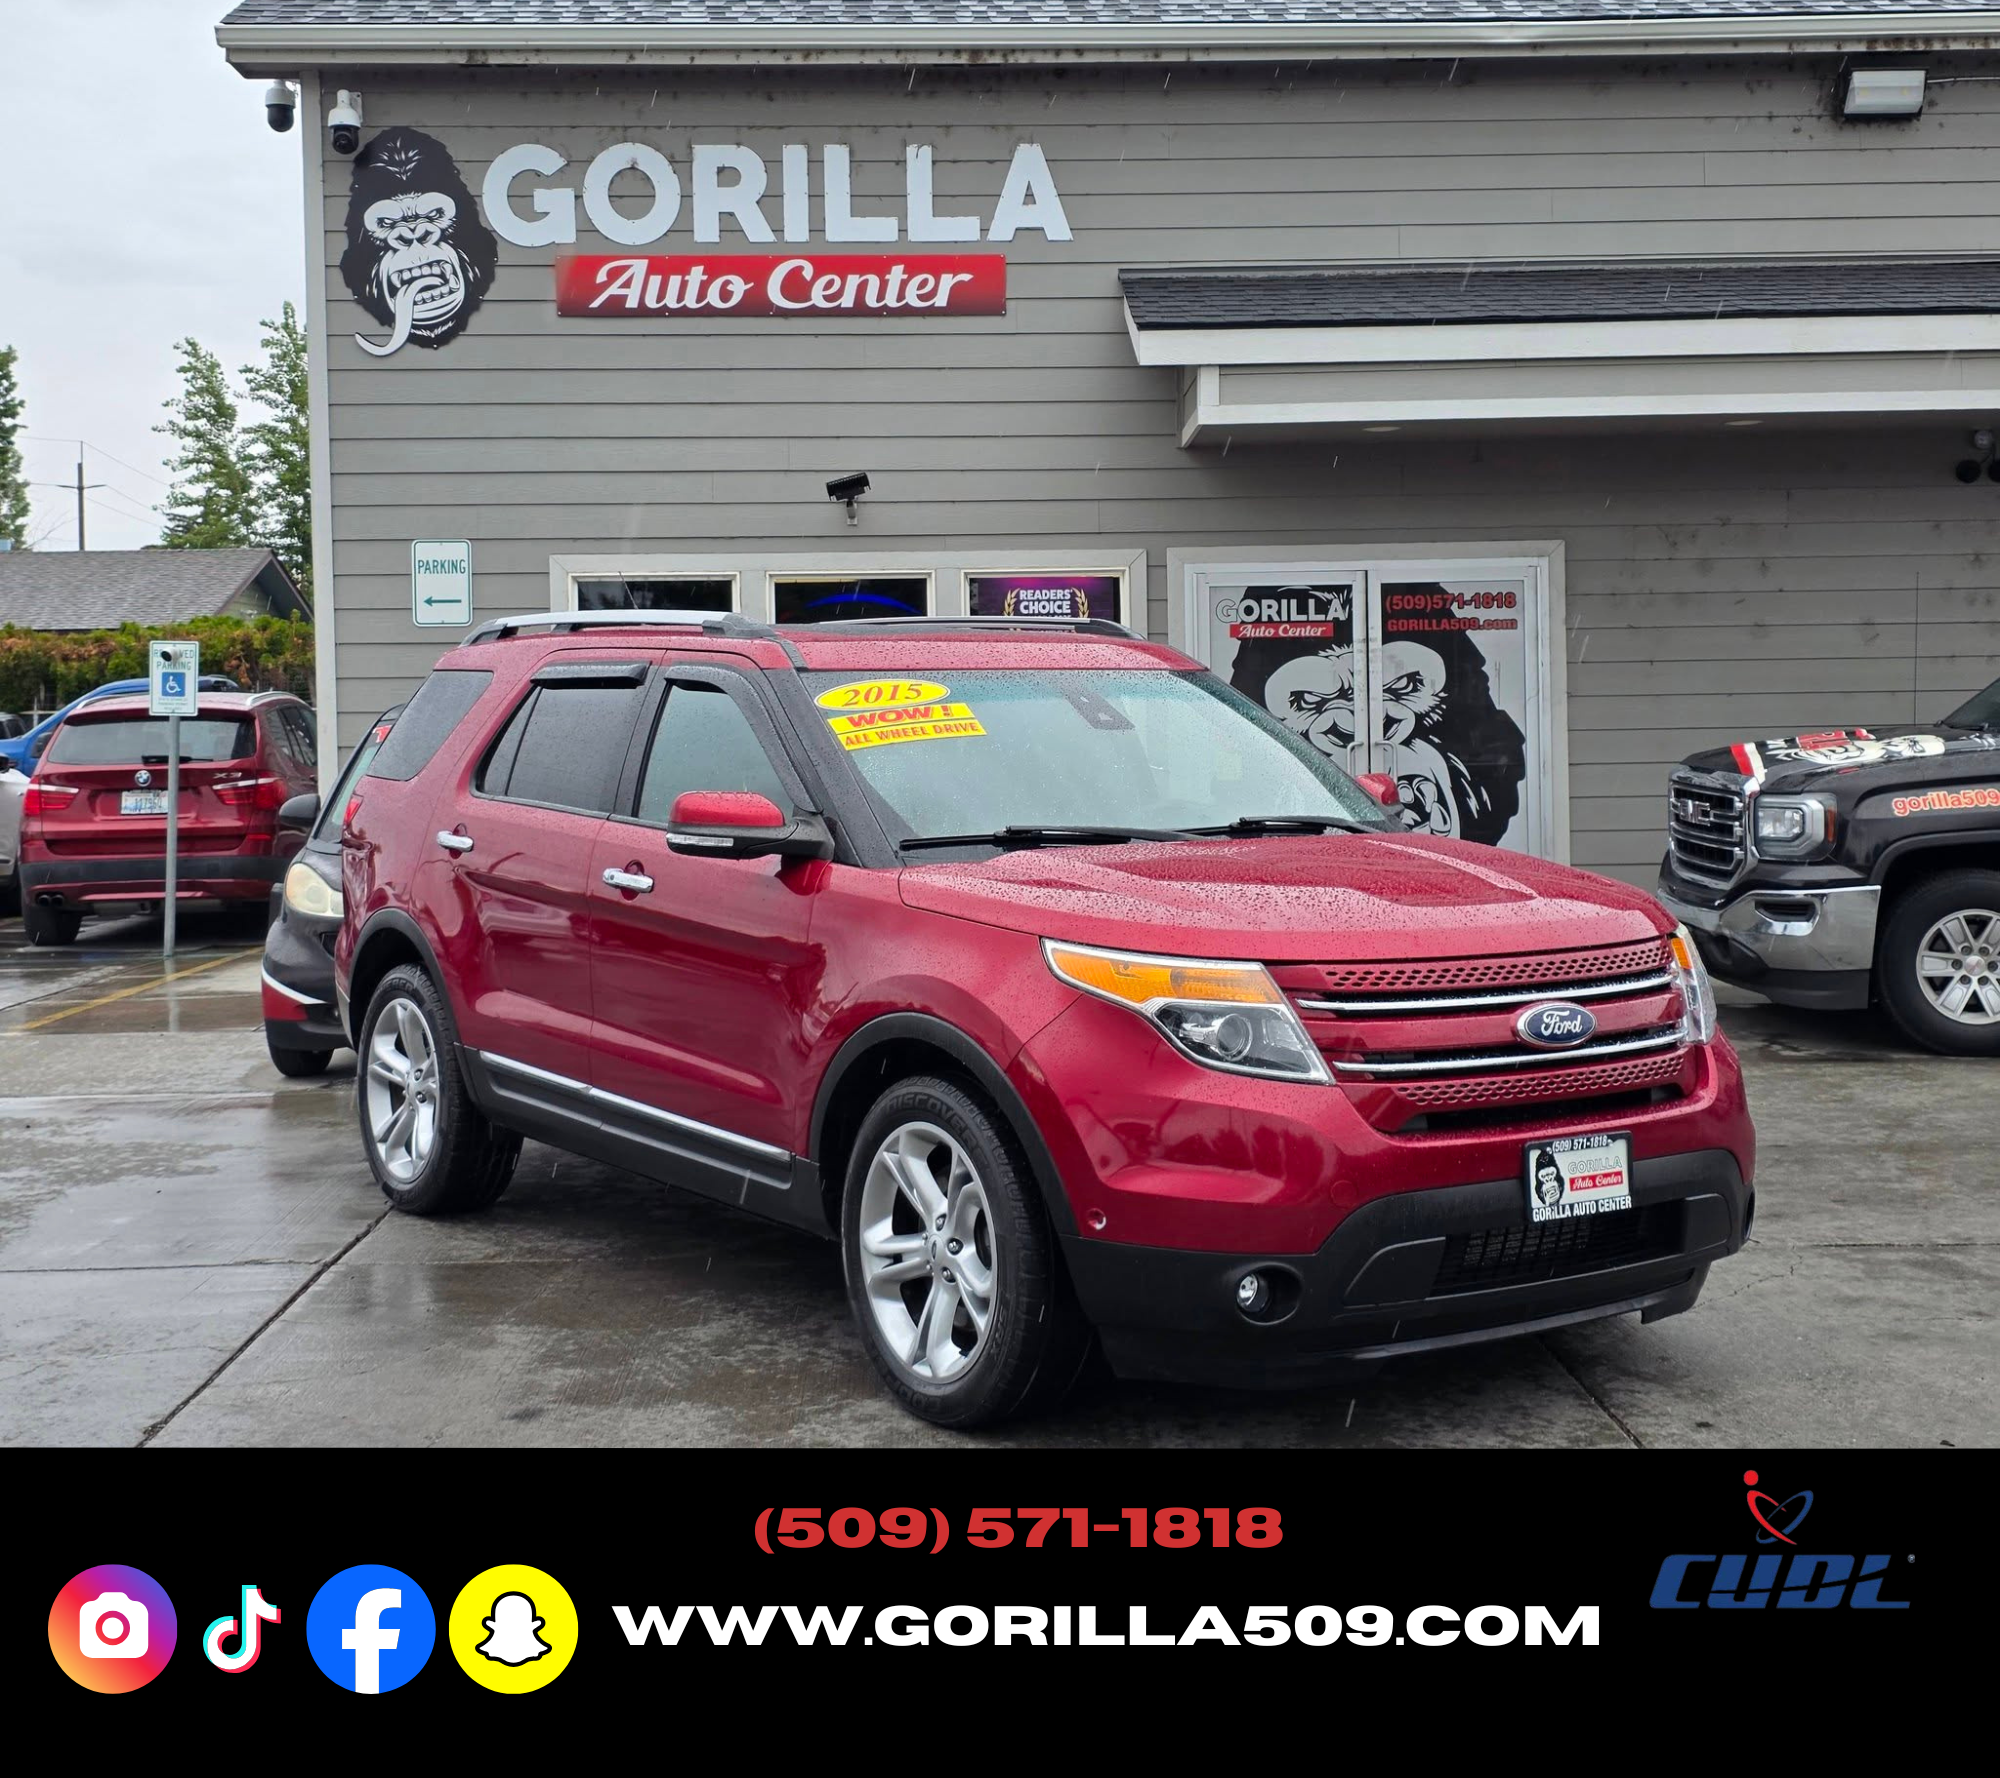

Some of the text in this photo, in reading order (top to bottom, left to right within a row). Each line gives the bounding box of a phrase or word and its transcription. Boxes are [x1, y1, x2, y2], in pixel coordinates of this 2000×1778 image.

[482, 142, 1075, 247] GORILLA
[590, 259, 974, 310] Auto Center
[417, 560, 467, 575] PARKING
[1020, 589, 1073, 600] READERS'
[1386, 592, 1516, 613] (509)571-1818
[1019, 600, 1072, 614] CHOICE
[1216, 598, 1346, 623] GORILLA
[1239, 624, 1326, 638] Auto Center
[1388, 617, 1518, 632] GORILLA509.com
[153, 648, 195, 659] REVED
[157, 660, 192, 671] PARKING
[842, 684, 922, 707] 2015
[847, 706, 934, 728] WOW
[845, 722, 979, 747] ALL WHEEL DRIVE
[1892, 788, 2000, 817] gorilla509
[1541, 1009, 1583, 1036] Ford
[1552, 1135, 1608, 1152] (509) 571-1818
[1568, 1156, 1622, 1175] GORILLA
[1572, 1173, 1622, 1191] Auto Center
[1573, 1200, 1597, 1217] AUTO
[1598, 1195, 1632, 1213] CENTER
